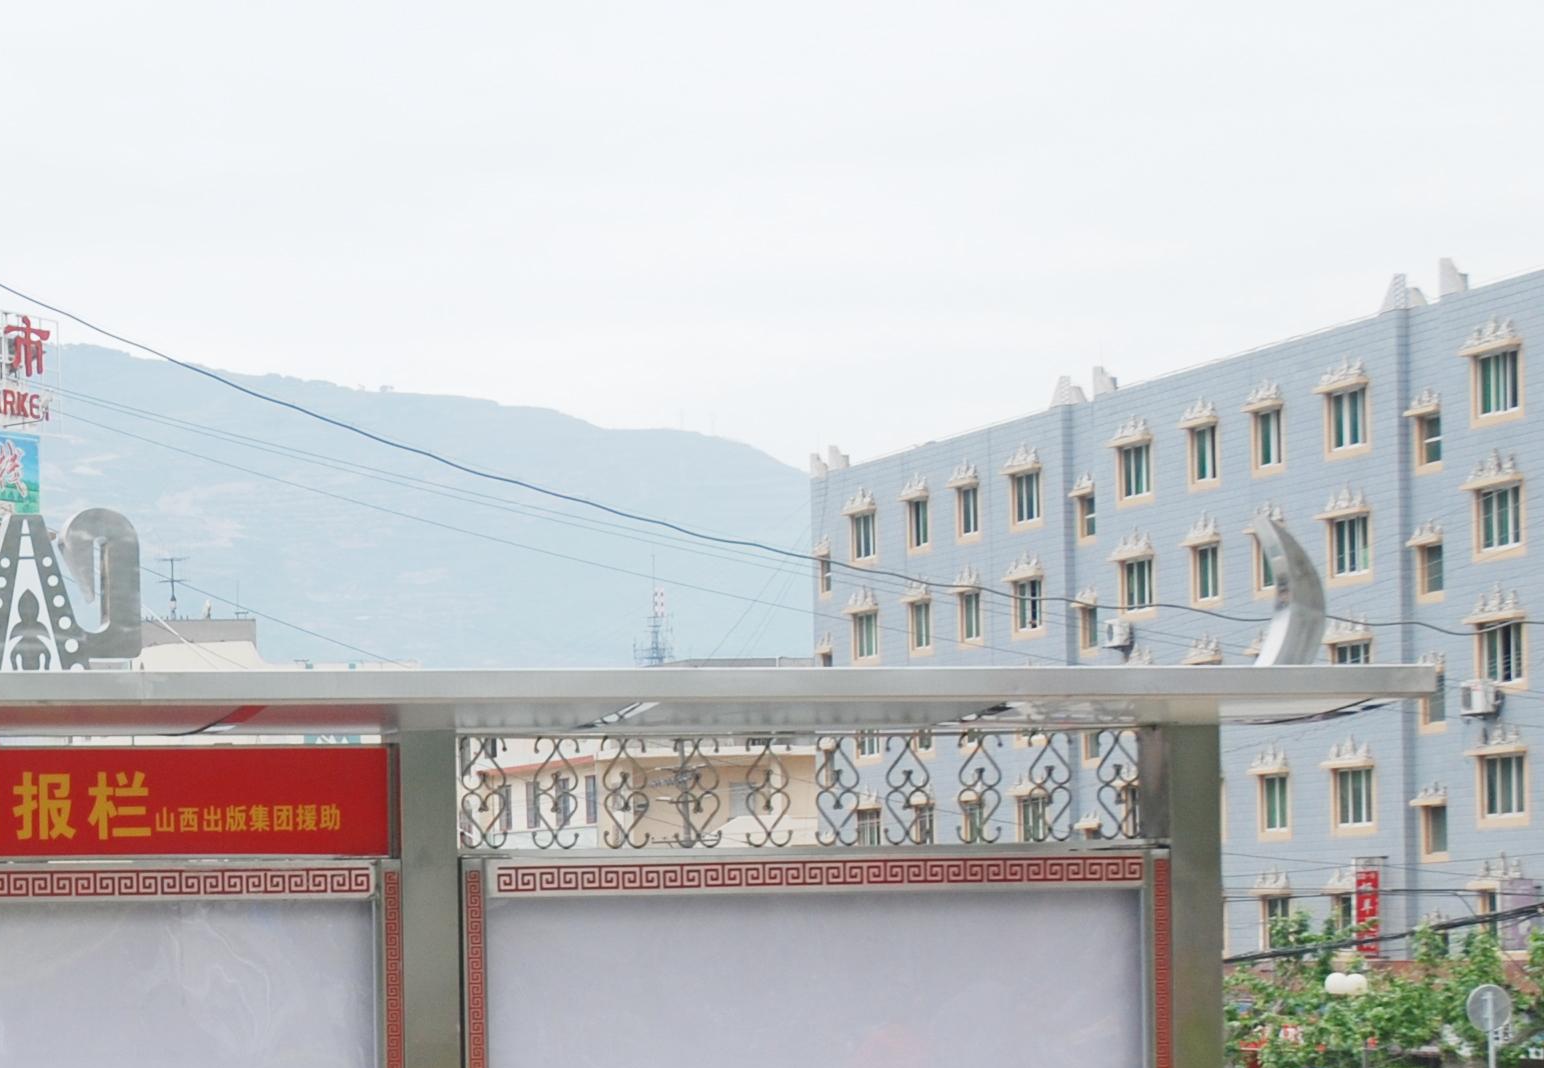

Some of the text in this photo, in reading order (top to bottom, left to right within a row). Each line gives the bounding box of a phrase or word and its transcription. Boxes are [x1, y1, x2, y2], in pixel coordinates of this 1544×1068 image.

[155, 803, 341, 832] 山西出版集团援助
